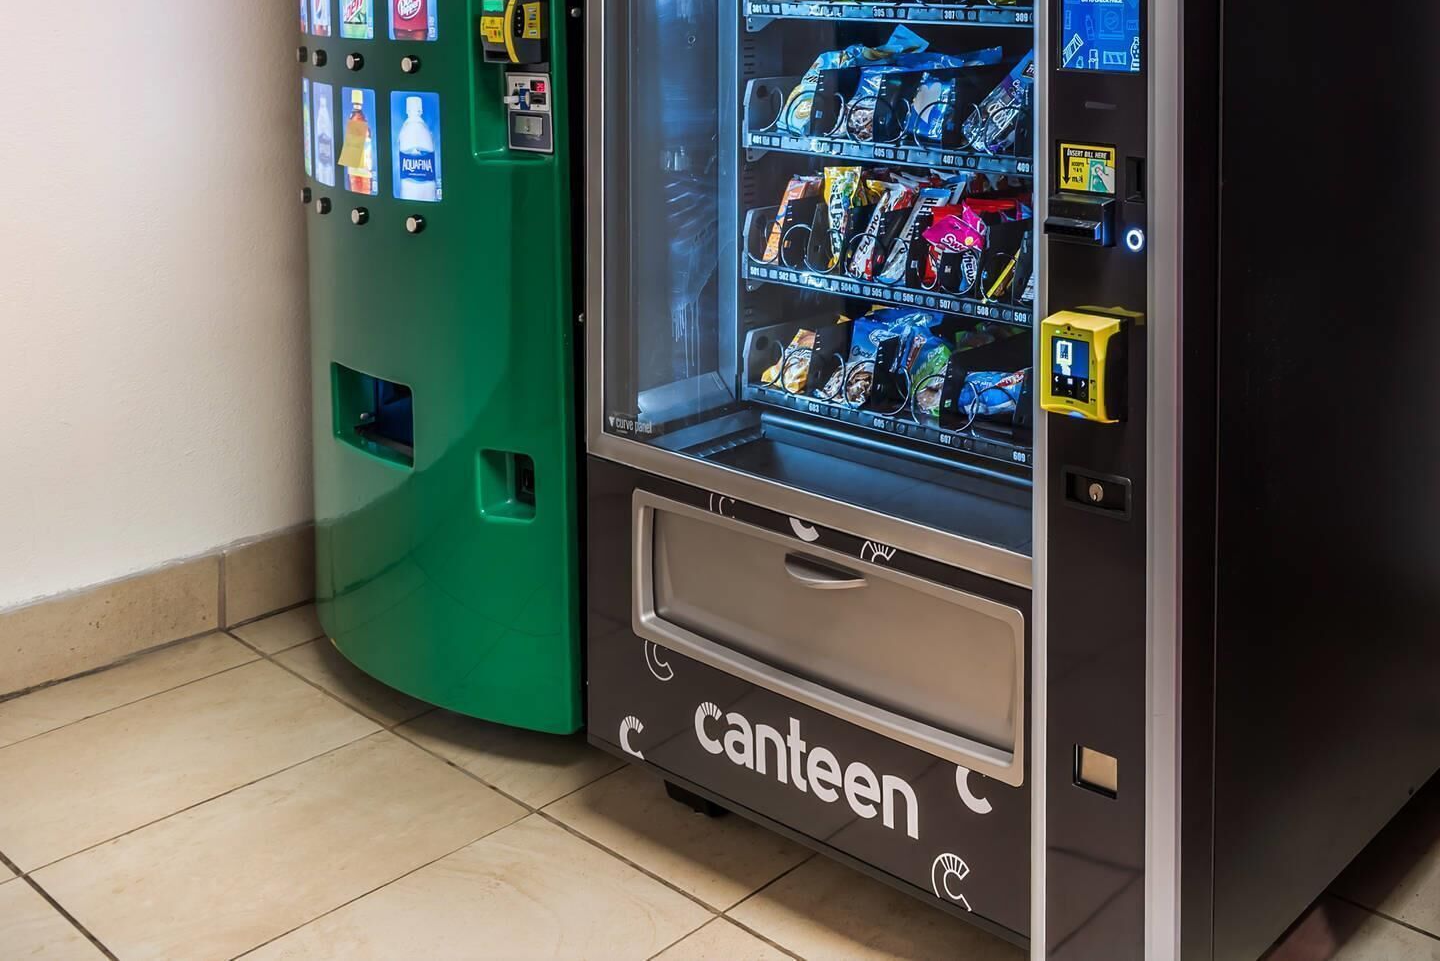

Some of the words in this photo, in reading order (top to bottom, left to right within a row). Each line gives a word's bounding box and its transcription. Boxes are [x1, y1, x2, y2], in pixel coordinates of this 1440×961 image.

[752, 4, 762, 13] 301
[873, 8, 885, 18] 305
[944, 10, 955, 19] 307
[1016, 13, 1028, 22] 309
[402, 158, 433, 173] AQUAFINA
[752, 135, 762, 144] 401
[874, 148, 885, 157] 405
[943, 155, 954, 164] 407
[1017, 162, 1029, 172] 409
[1067, 148, 1083, 158] INSERT
[750, 267, 760, 276] 501
[779, 270, 789, 280] 502
[872, 287, 882, 297] 505
[902, 293, 914, 303] 506
[940, 299, 950, 309] 507
[976, 305, 989, 316] 508
[1014, 311, 1026, 322] 509
[616, 418, 633, 430] curve
[635, 421, 652, 434] panel
[808, 403, 819, 412] 603
[873, 419, 885, 428] 605
[940, 434, 951, 443] 607
[1013, 451, 1025, 462] 609
[694, 701, 920, 840] canteen
